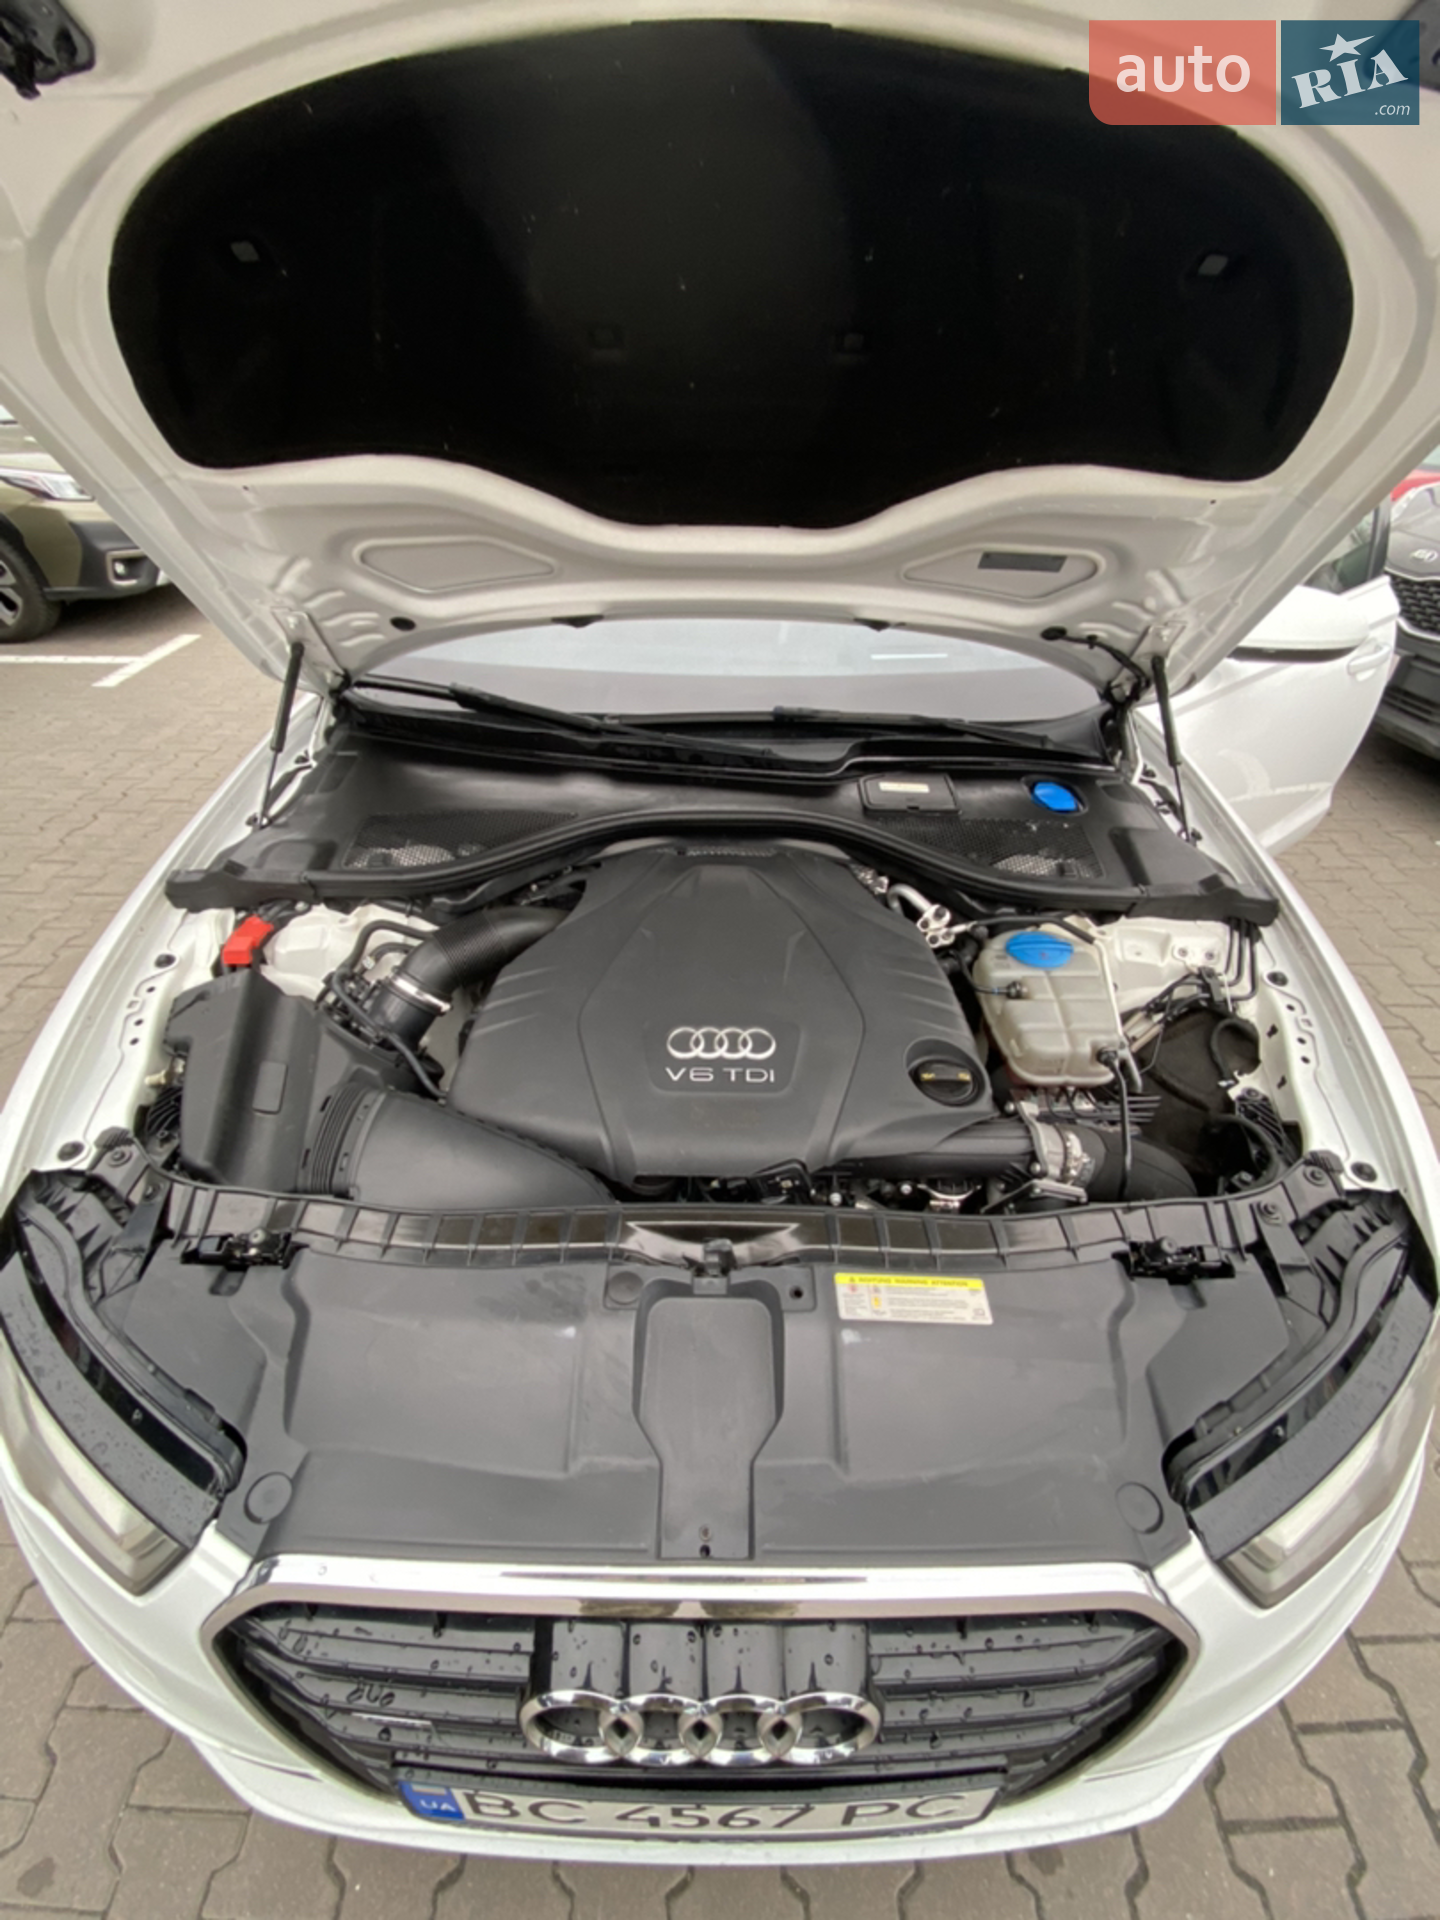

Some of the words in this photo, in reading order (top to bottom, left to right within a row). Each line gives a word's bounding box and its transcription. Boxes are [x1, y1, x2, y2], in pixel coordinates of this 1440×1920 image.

[665, 1067, 714, 1082] V6
[723, 1068, 775, 1083] TDI
[420, 1799, 456, 1813] UA
[463, 1790, 587, 1824] BC
[615, 1803, 814, 1828] 4567
[841, 1795, 965, 1826] PC
